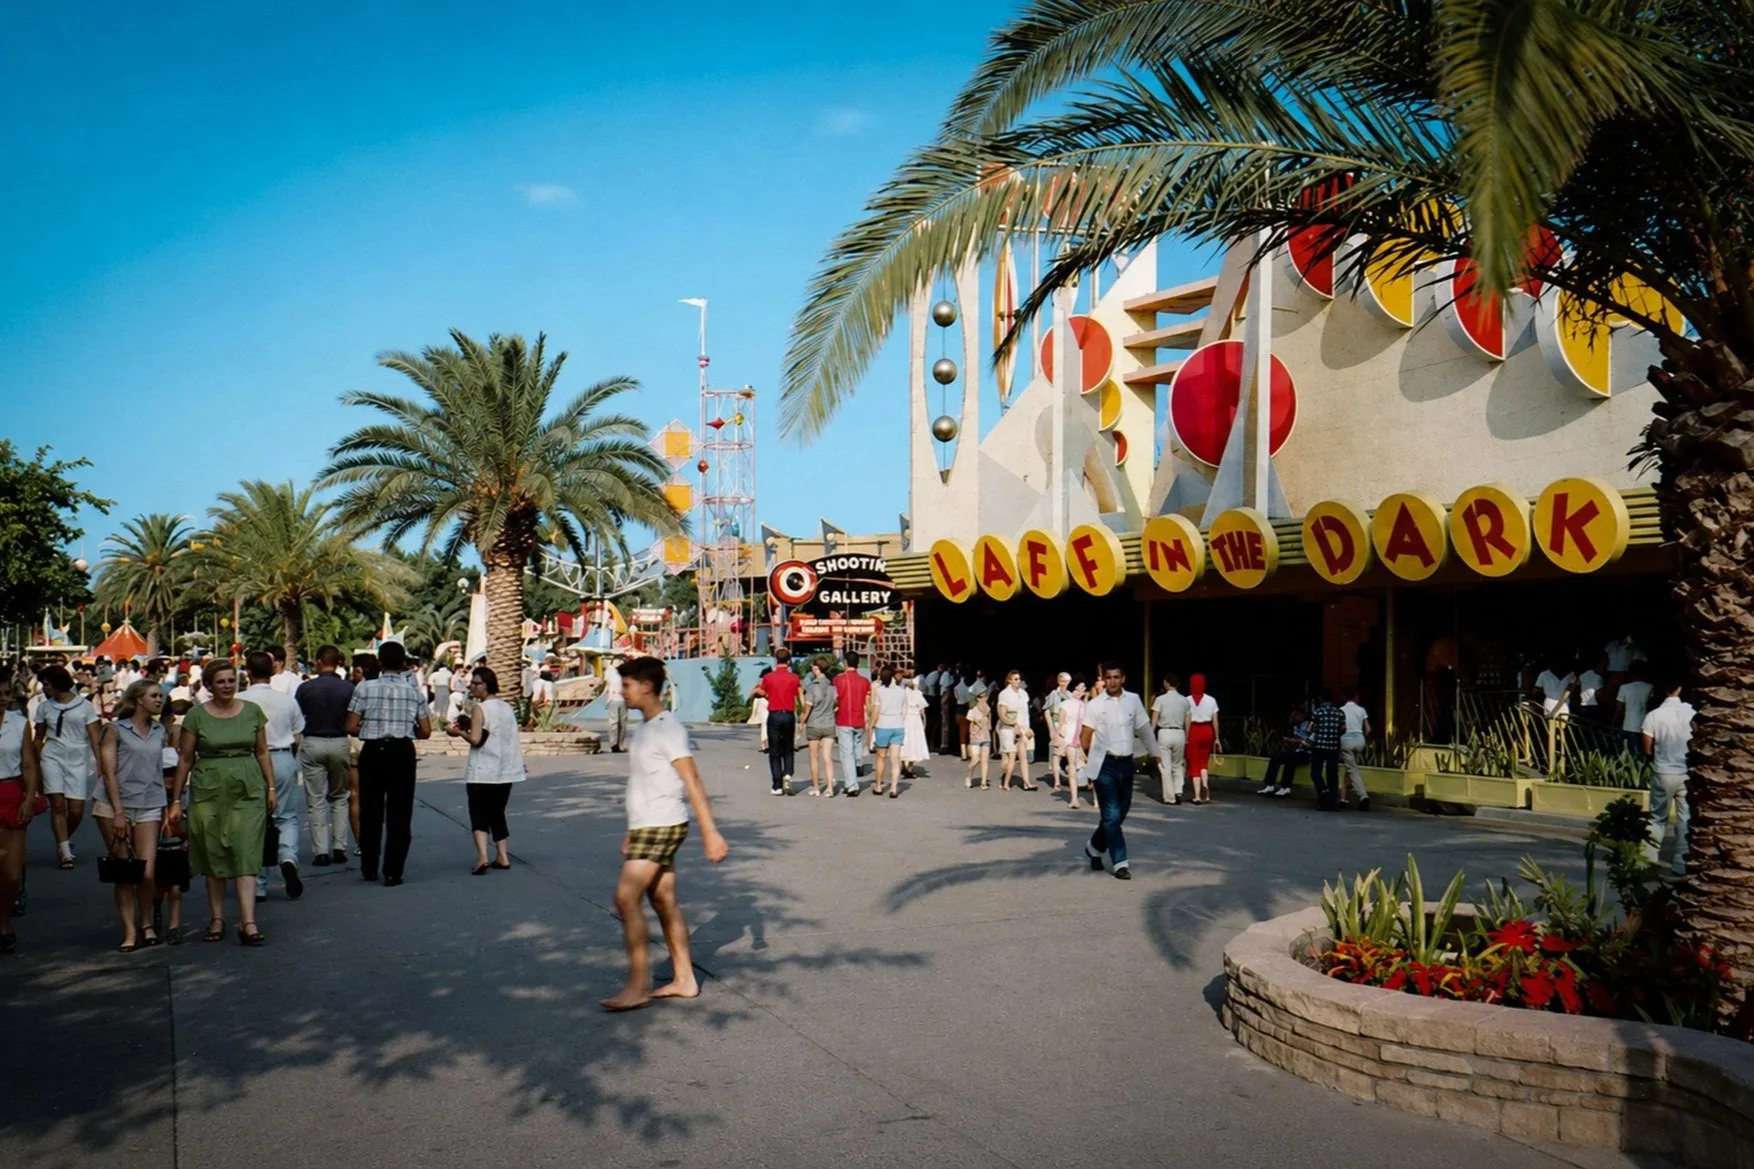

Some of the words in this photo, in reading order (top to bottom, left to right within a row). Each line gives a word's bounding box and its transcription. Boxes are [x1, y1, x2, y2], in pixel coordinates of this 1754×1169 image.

[933, 534, 1099, 597] LAFF
[1149, 538, 1192, 573] IN
[1210, 530, 1266, 573] THE
[1310, 492, 1600, 577] DARK
[819, 590, 891, 604] GALLERY
